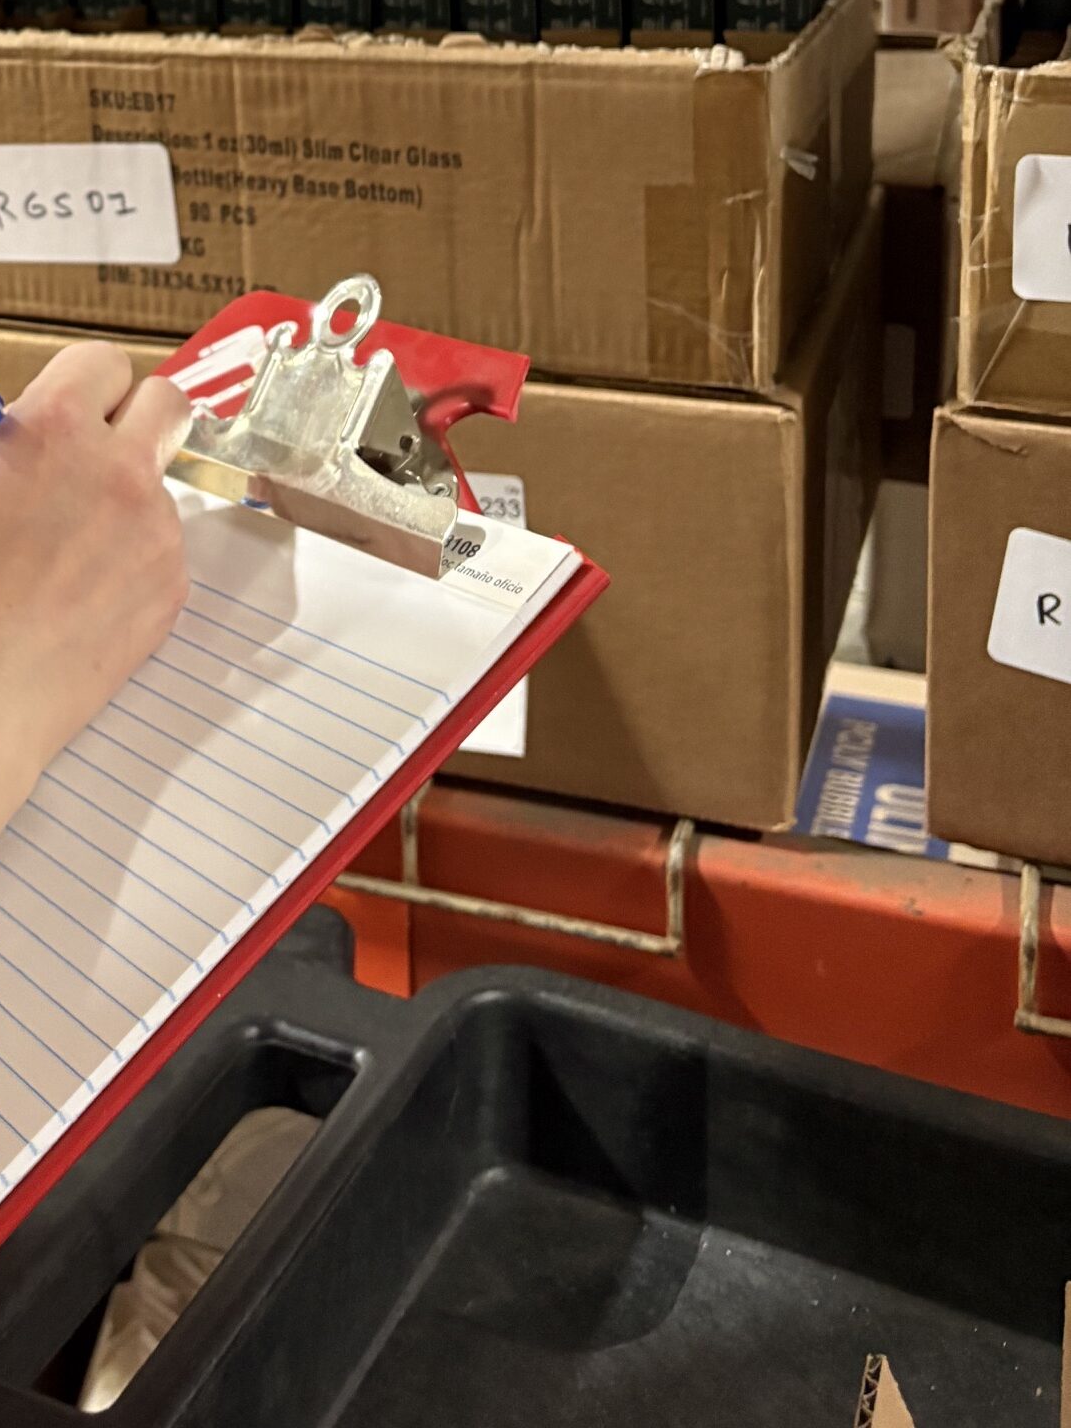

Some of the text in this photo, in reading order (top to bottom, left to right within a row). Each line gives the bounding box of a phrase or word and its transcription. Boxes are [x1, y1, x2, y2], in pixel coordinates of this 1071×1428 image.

[302, 136, 344, 161] Slim
[348, 141, 402, 165] Clear
[406, 145, 463, 169] Glass
[292, 174, 340, 198] Base
[344, 177, 423, 211] Bottom)
[220, 204, 257, 225] PCS
[479, 496, 521, 519] 233
[454, 561, 494, 584] tamaño
[493, 575, 524, 595] oficio
